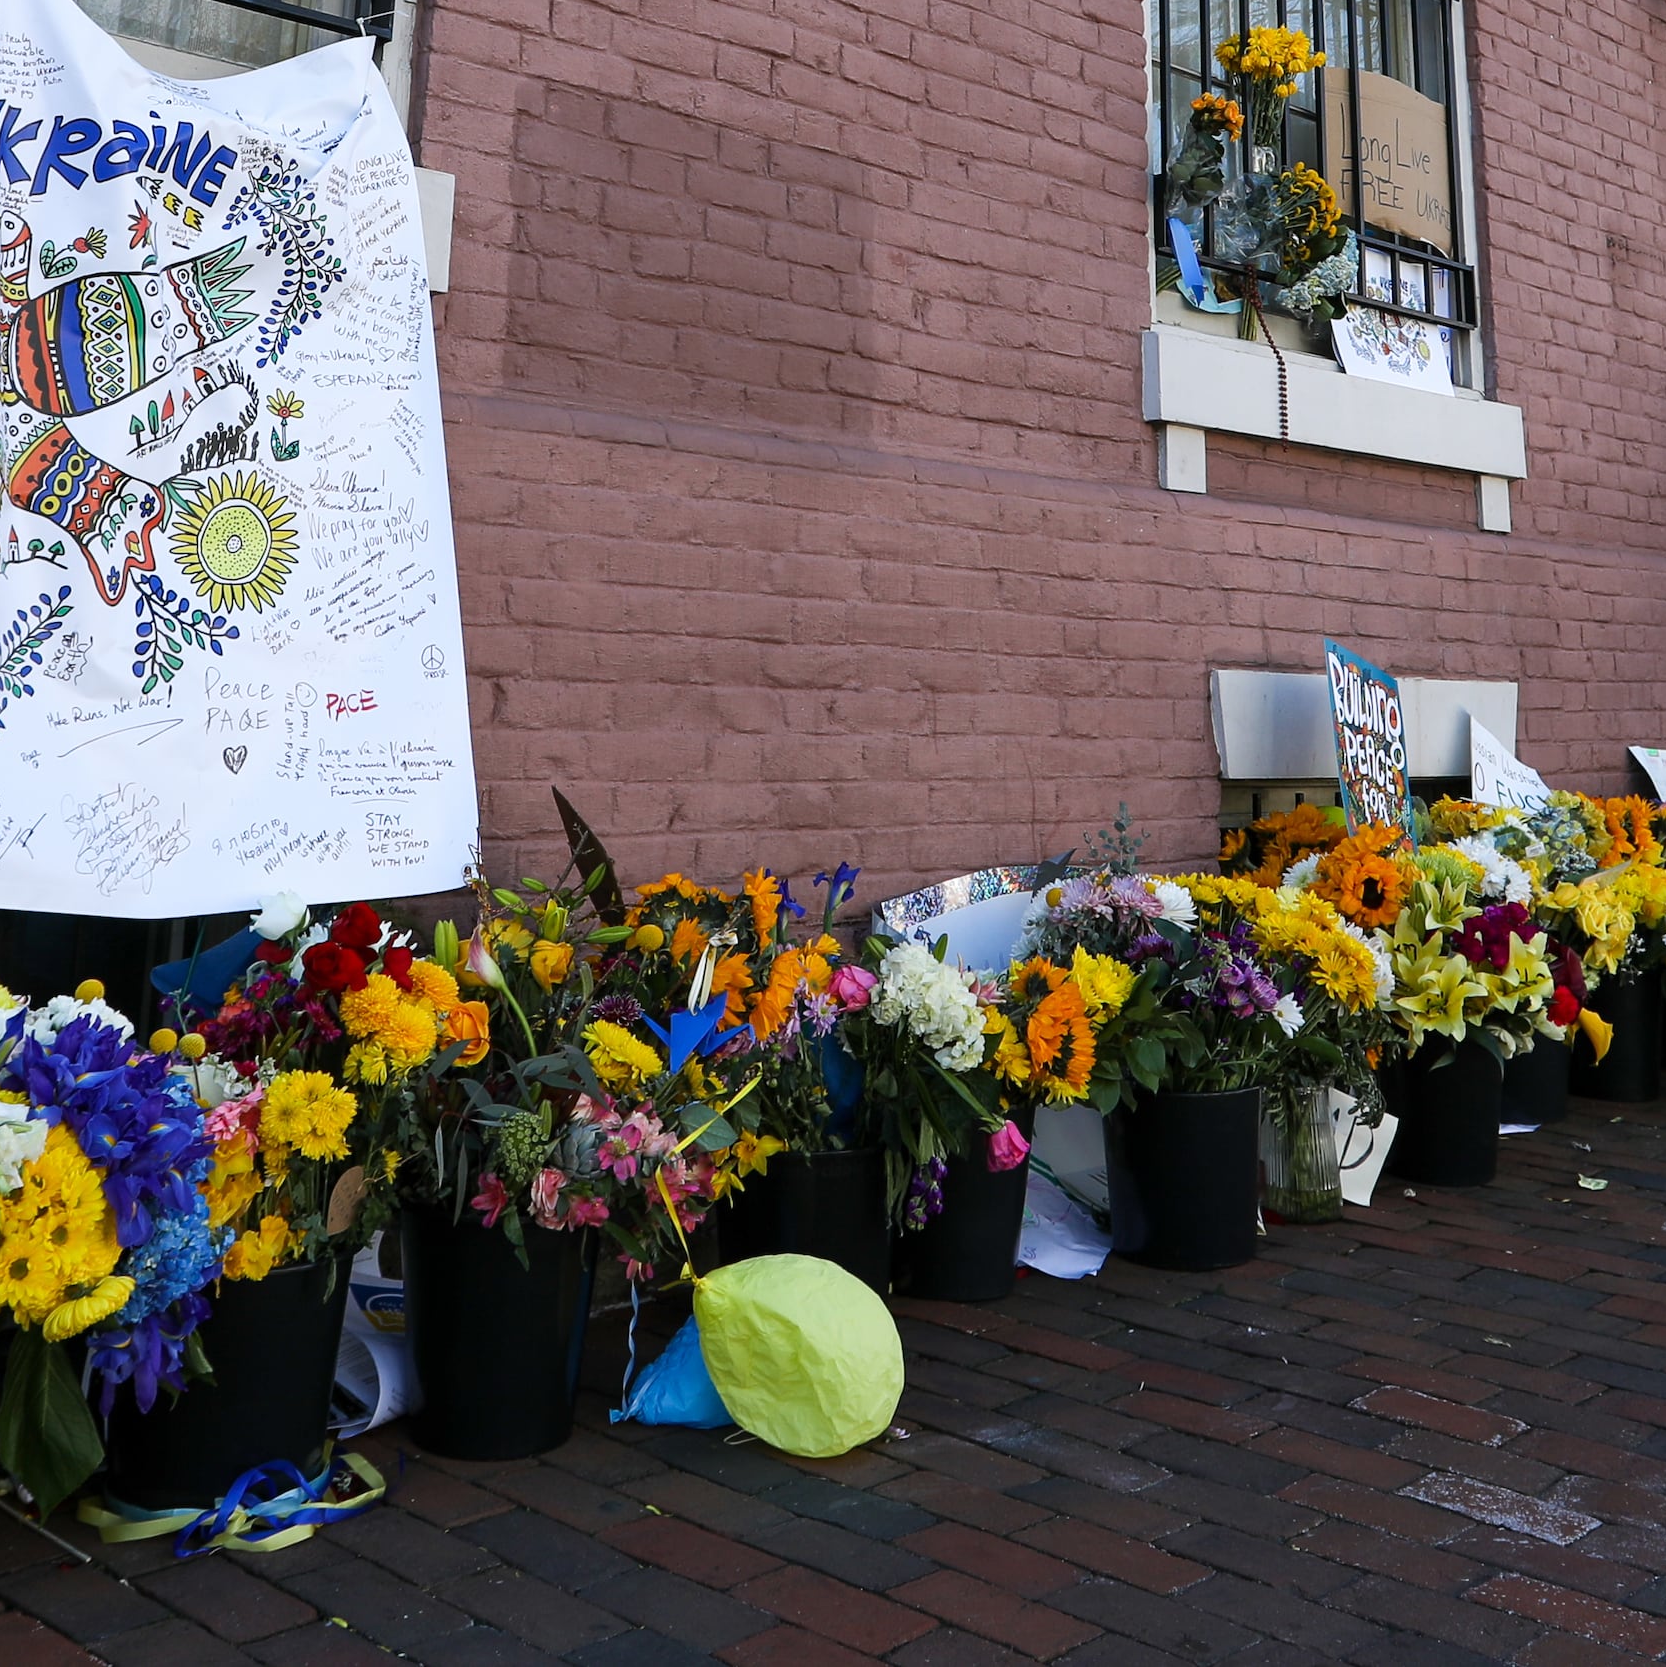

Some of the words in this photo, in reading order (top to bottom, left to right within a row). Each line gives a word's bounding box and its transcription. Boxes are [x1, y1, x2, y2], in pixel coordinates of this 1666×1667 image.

[1341, 102, 1391, 183] Long
[1396, 118, 1430, 174] Live
[355, 155, 382, 173] LONG
[383, 149, 409, 168] LIVE
[349, 174, 367, 186] THE
[369, 165, 403, 182] PEOPLE
[357, 177, 398, 196] UKRAINE
[1340, 168, 1404, 210] FREE
[366, 304, 377, 315] on
[372, 323, 399, 343] begin
[295, 350, 319, 365] Glory
[320, 352, 330, 361] to
[312, 370, 396, 388] ESPERANZA
[308, 512, 327, 541] We
[331, 517, 357, 541] pray
[361, 513, 377, 530] for
[384, 514, 402, 538] you
[311, 546, 333, 570] We
[340, 543, 358, 562] are
[363, 535, 383, 560] your
[392, 527, 414, 552] ally
[204, 666, 274, 701] Peace
[113, 697, 133, 714] Not
[138, 685, 174, 709] War!
[326, 689, 379, 721] PACE
[1344, 726, 1395, 795] PEACE
[1474, 742, 1496, 766] ussian
[365, 813, 401, 826] STAY
[211, 838, 223, 856] Я
[228, 819, 281, 850] люблю
[365, 828, 414, 841] STRONG!
[368, 844, 388, 854] WE
[393, 840, 429, 850] STAND
[371, 857, 400, 868] WITH
